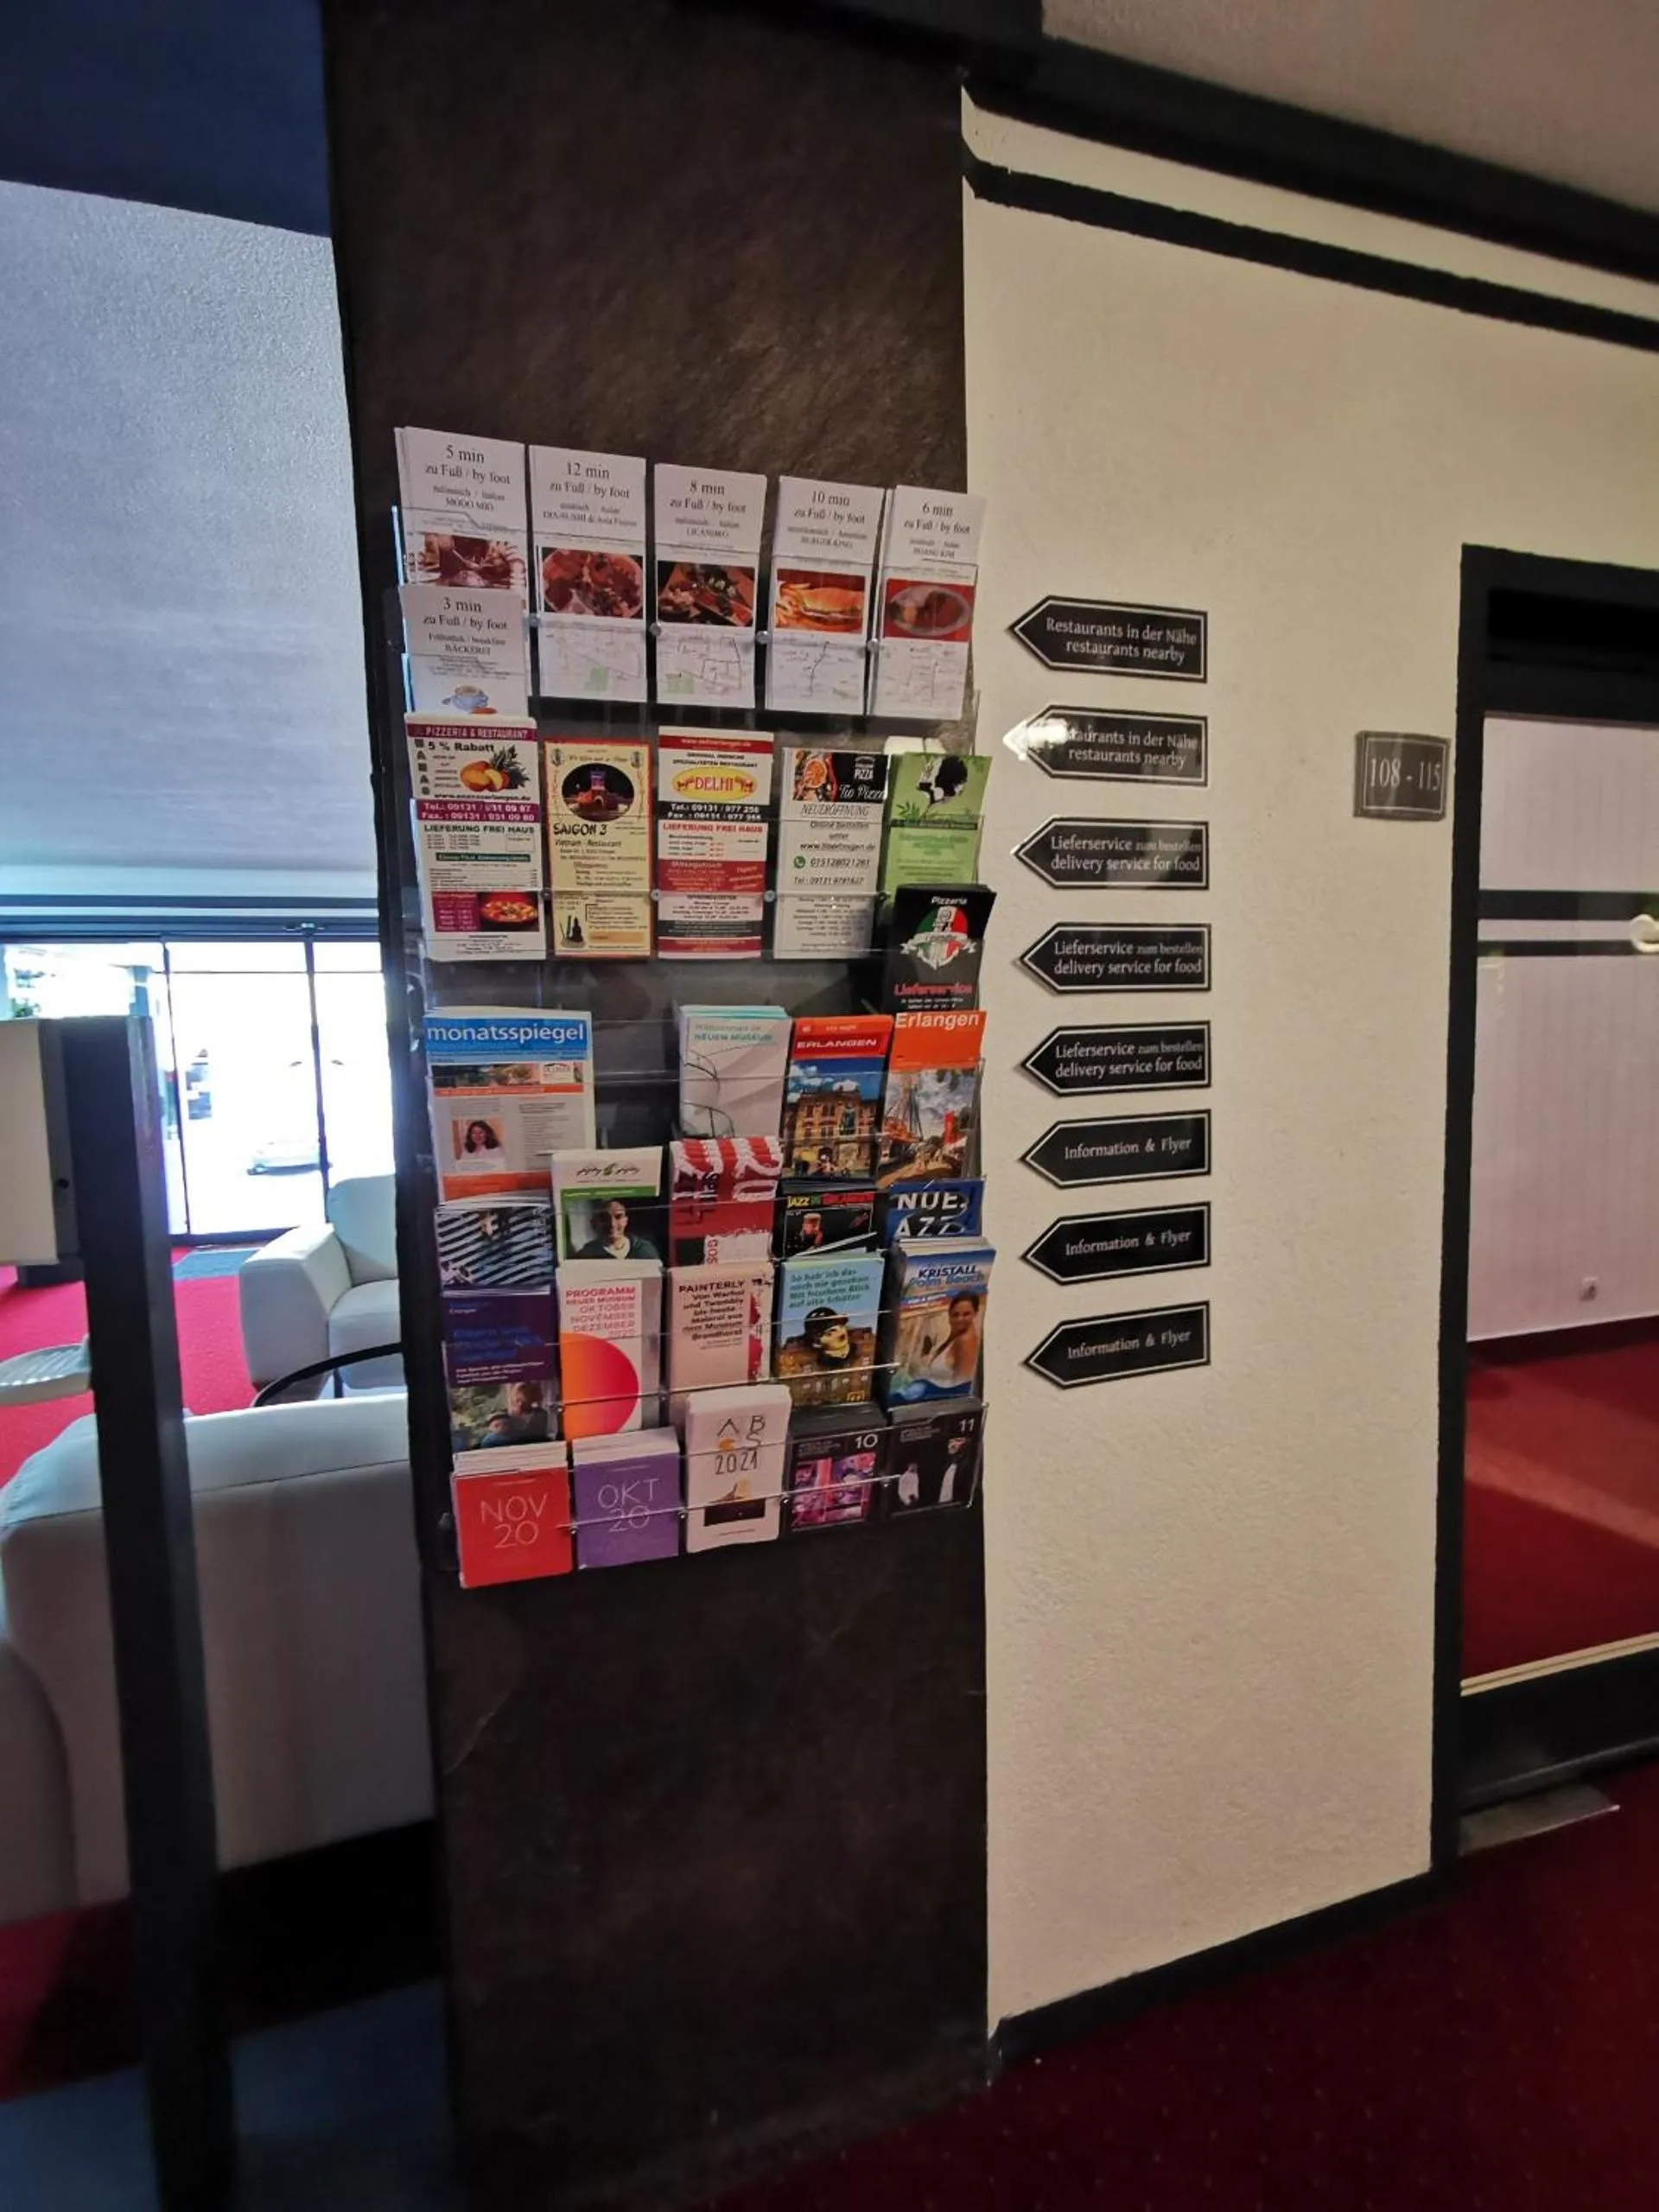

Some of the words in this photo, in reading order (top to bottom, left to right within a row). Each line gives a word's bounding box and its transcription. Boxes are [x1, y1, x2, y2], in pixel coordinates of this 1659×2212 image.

[446, 444, 454, 459] 5
[458, 448, 485, 463] min
[425, 465, 438, 475] zu
[473, 467, 486, 484] by
[490, 470, 511, 485] foot
[567, 462, 582, 476] 12
[586, 465, 610, 479] min
[550, 483, 562, 492] zu
[594, 484, 607, 499] by
[610, 486, 630, 499] foot
[702, 484, 725, 495] min
[811, 490, 825, 504] 10
[828, 495, 850, 506] min
[670, 499, 682, 508] zu
[712, 500, 724, 515] by
[728, 501, 747, 513] foot
[922, 503, 931, 514] 6
[933, 505, 954, 517] min
[833, 511, 846, 524] by
[847, 512, 867, 524] foot
[940, 522, 952, 536] by
[954, 522, 970, 535] foot
[443, 596, 452, 611] 3
[456, 600, 481, 613] min
[423, 615, 435, 624] zu
[469, 618, 484, 631] by
[486, 619, 508, 630] foot
[1046, 616, 1124, 639] Restaurants
[1126, 623, 1140, 639] in
[1141, 625, 1163, 641] der
[1166, 628, 1198, 646] Nähe
[1065, 639, 1141, 658] restaurants
[1142, 645, 1186, 667] nearby
[425, 727, 468, 737] PIZZERIA
[477, 728, 529, 741] RESTAURANT
[1128, 731, 1141, 745] in
[1143, 731, 1164, 748] der
[1166, 734, 1199, 750] Nähe
[428, 741, 435, 751] 5
[439, 741, 450, 752] %
[1068, 747, 1141, 764] restaurants
[1144, 751, 1187, 771] nearby
[855, 769, 874, 780] PIZZA
[1370, 757, 1402, 789] 108
[1418, 760, 1441, 791] 115
[694, 776, 734, 791] DELHI
[424, 824, 480, 833] LIEFERUNG
[483, 825, 505, 835] FREI
[553, 823, 596, 836] SAIGON
[599, 824, 607, 836] 3
[1050, 834, 1133, 852] Lieferservice
[1051, 854, 1105, 874] delivery
[1106, 857, 1151, 871] service
[1154, 856, 1173, 871] for
[1174, 855, 1201, 872] food
[931, 895, 968, 905] Pizzeria
[1053, 939, 1135, 956] Lieferservice
[1136, 944, 1158, 956] zum
[1159, 941, 1205, 956] bestellen
[1053, 958, 1106, 979] delivery
[1107, 960, 1152, 975] service
[1154, 958, 1173, 974] for
[1174, 957, 1203, 974] food
[895, 1012, 980, 1030] Erlangen
[427, 1023, 584, 1045] monatsspiegel
[797, 1039, 877, 1049] ERLANGEN
[1055, 1041, 1135, 1059] Lieferservice
[1137, 1046, 1160, 1055] zum
[1160, 1040, 1205, 1053] bestellen
[1055, 1061, 1107, 1079] delivery
[1109, 1059, 1154, 1076] service
[1155, 1057, 1174, 1072] for
[1176, 1055, 1204, 1071] food
[1064, 1142, 1140, 1161] Information
[1145, 1137, 1156, 1153] &
[1160, 1135, 1192, 1155] Flyer
[787, 1195, 810, 1209] JAZZ
[1065, 1236, 1140, 1256] Information
[1145, 1231, 1156, 1247] &
[1160, 1230, 1192, 1248] Flyer
[918, 1265, 976, 1279] KRISTALL
[566, 1287, 636, 1297] PROGRAMM
[678, 1280, 746, 1294] PAINTERLY
[1066, 1338, 1141, 1360] Information
[1145, 1333, 1156, 1348] &
[1160, 1329, 1192, 1349] Flyer
[959, 1418, 976, 1433] 11
[855, 1433, 880, 1449] 10
[715, 1451, 759, 1476] 2021
[598, 1478, 659, 1510] OKT
[480, 1492, 549, 1524] NOV
[608, 1504, 650, 1533] 20
[494, 1520, 539, 1549] 20
